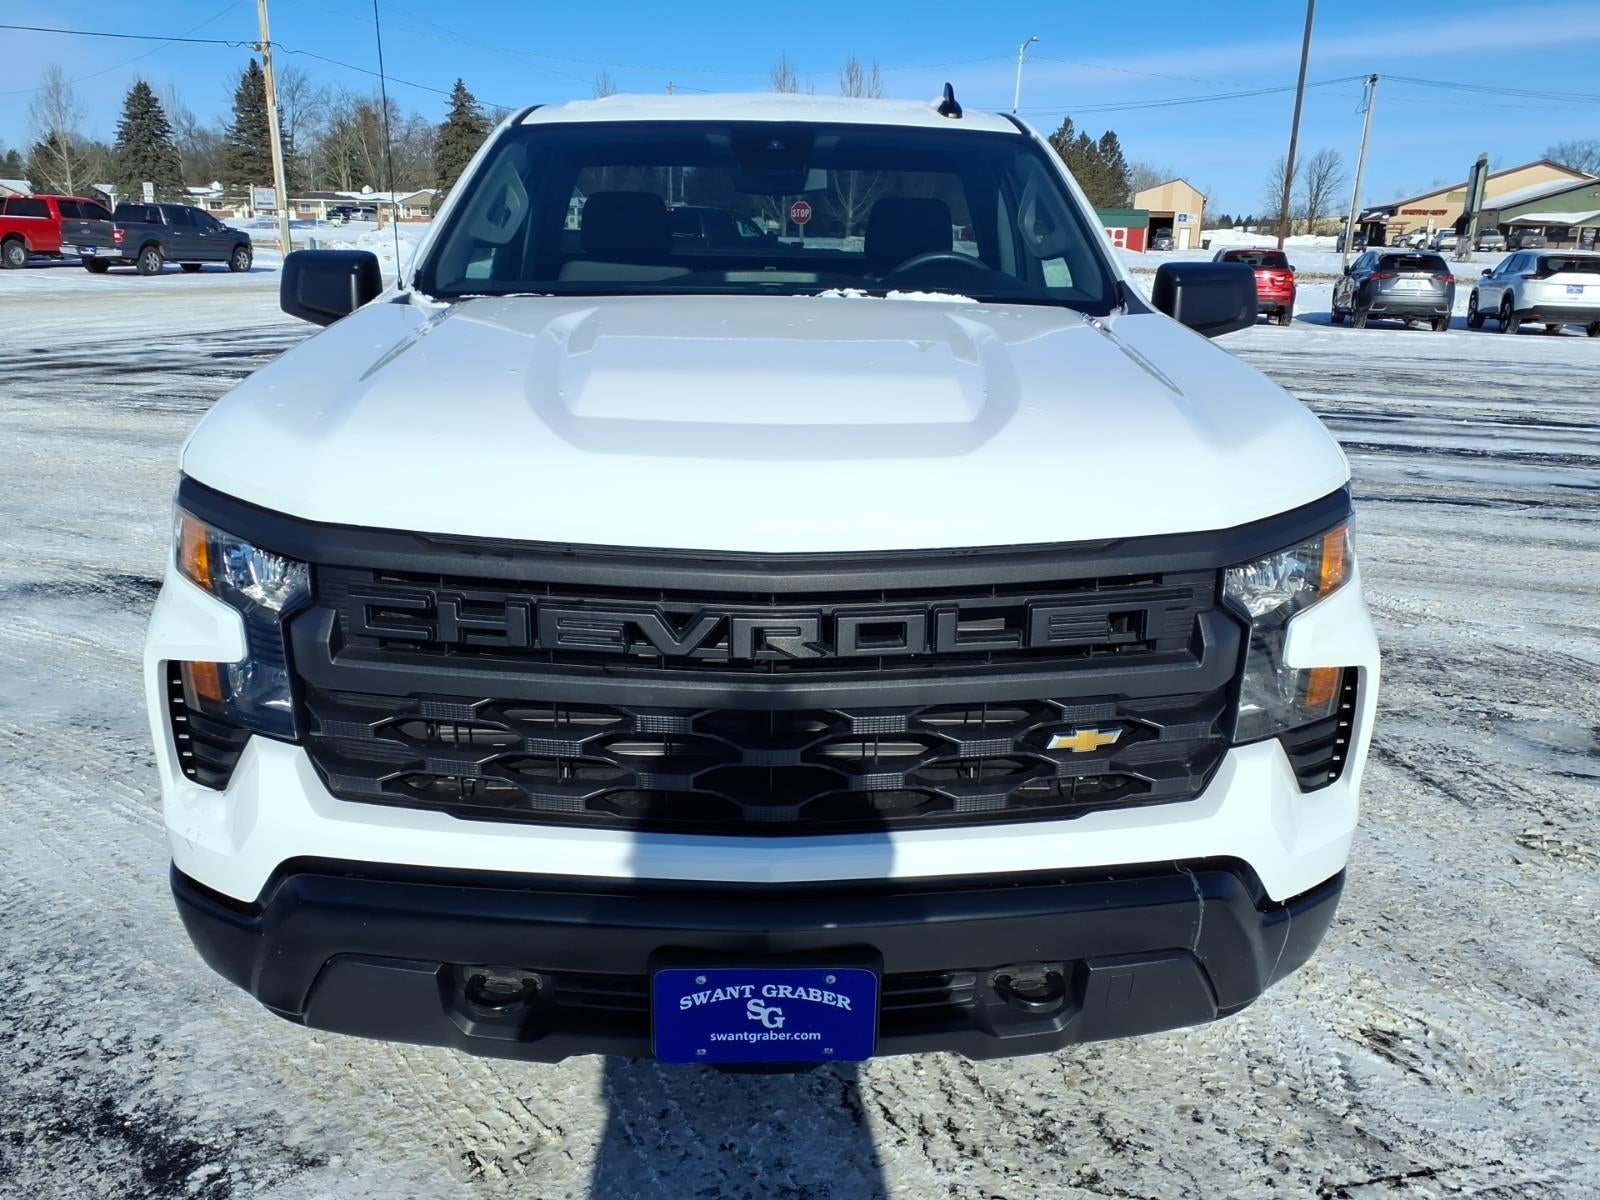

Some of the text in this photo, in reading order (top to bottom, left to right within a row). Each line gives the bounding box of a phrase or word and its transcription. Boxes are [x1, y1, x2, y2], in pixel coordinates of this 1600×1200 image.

[792, 209, 809, 217] STOP
[348, 587, 1194, 661] CHEVROLET
[679, 984, 852, 1011] SWANT GRABER
[746, 998, 785, 1029] SG
[710, 1030, 821, 1043] swantgraber.com
